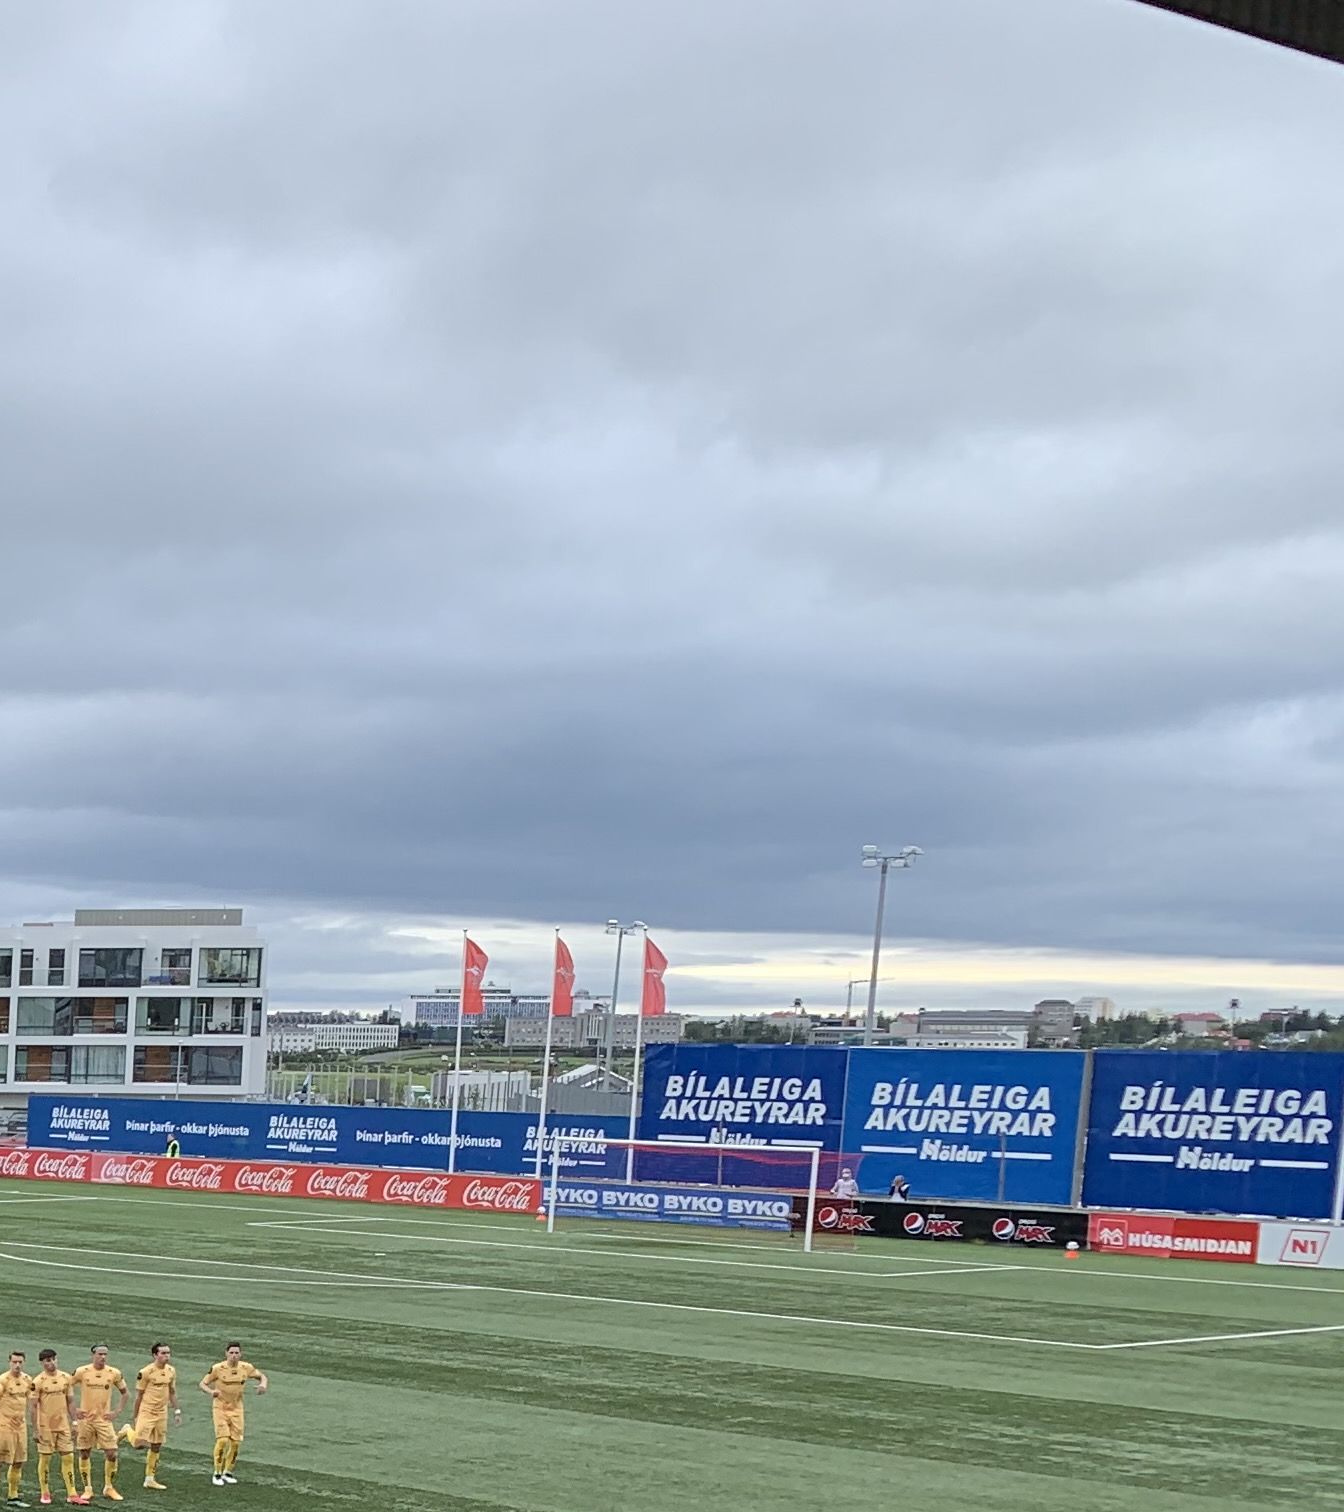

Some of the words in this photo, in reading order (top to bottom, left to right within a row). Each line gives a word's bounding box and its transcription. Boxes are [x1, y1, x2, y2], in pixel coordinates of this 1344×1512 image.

[664, 1070, 823, 1101] BÍLALEIGA
[870, 1077, 1052, 1111] BÍLALEIGA
[1119, 1080, 1328, 1116] BÍLALEIGA
[52, 1105, 109, 1120] BÍLALEIGA
[269, 1113, 337, 1130] BÍLALEIGA
[659, 1098, 827, 1126] AKUREYRAR
[50, 1118, 110, 1131] AKUREYRAR
[126, 1120, 149, 1132] Þínar
[150, 1121, 175, 1134] þarfir
[181, 1124, 207, 1135] okkar
[208, 1124, 250, 1138] þjónusta
[863, 1107, 1056, 1138] AKUREYRAR
[1111, 1112, 1334, 1145] AKUREYRAR
[267, 1127, 338, 1142] AKUREYRAR
[356, 1130, 383, 1143] Þínar
[384, 1131, 414, 1145] þarfir
[919, 1138, 988, 1164] Höldur
[1175, 1145, 1256, 1173] Höldur
[543, 1187, 598, 1205] BYKO
[602, 1190, 659, 1209] BYKO
[664, 1194, 723, 1213] BYKO
[727, 1198, 790, 1218] BYKO
[1291, 1239, 1318, 1255] N1
